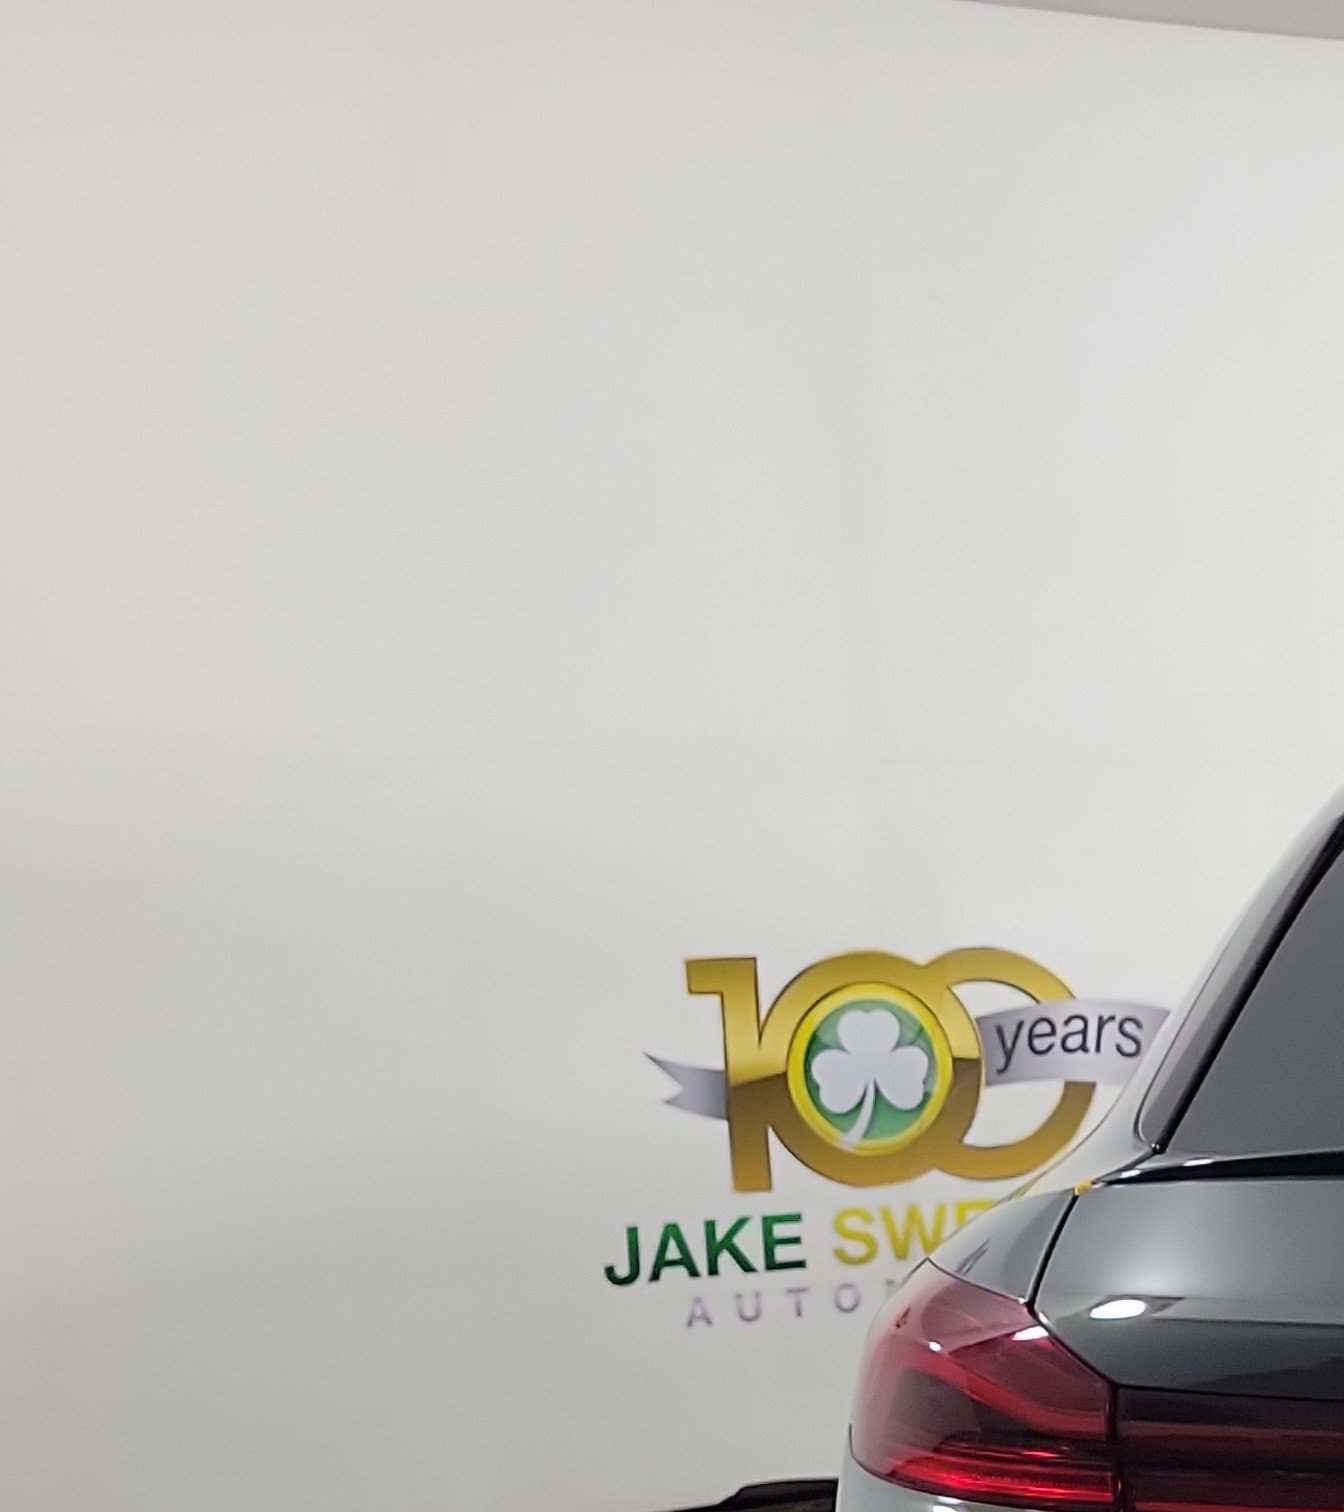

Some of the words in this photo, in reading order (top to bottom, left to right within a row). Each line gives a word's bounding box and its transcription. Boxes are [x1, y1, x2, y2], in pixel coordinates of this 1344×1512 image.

[685, 948, 1097, 1193] 100
[994, 1011, 1145, 1074] years
[604, 1212, 808, 1287] JAKE
[686, 1278, 896, 1329] AUTO
